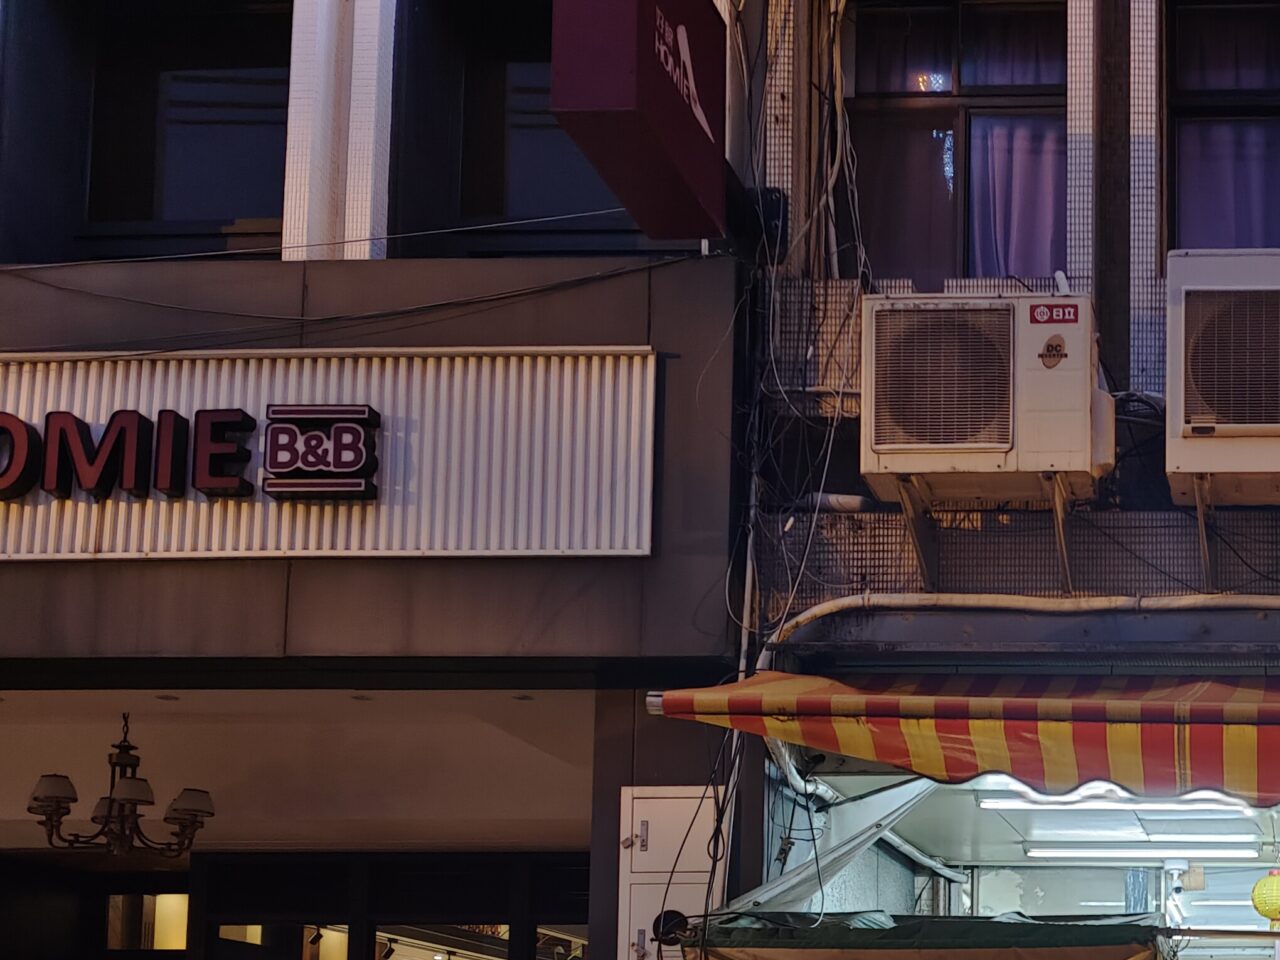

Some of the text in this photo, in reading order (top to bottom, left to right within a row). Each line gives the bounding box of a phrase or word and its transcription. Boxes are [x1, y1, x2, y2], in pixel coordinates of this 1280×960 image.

[1053, 307, 1075, 320] 日立
[1046, 344, 1062, 353] DC
[264, 421, 368, 474] B&B
